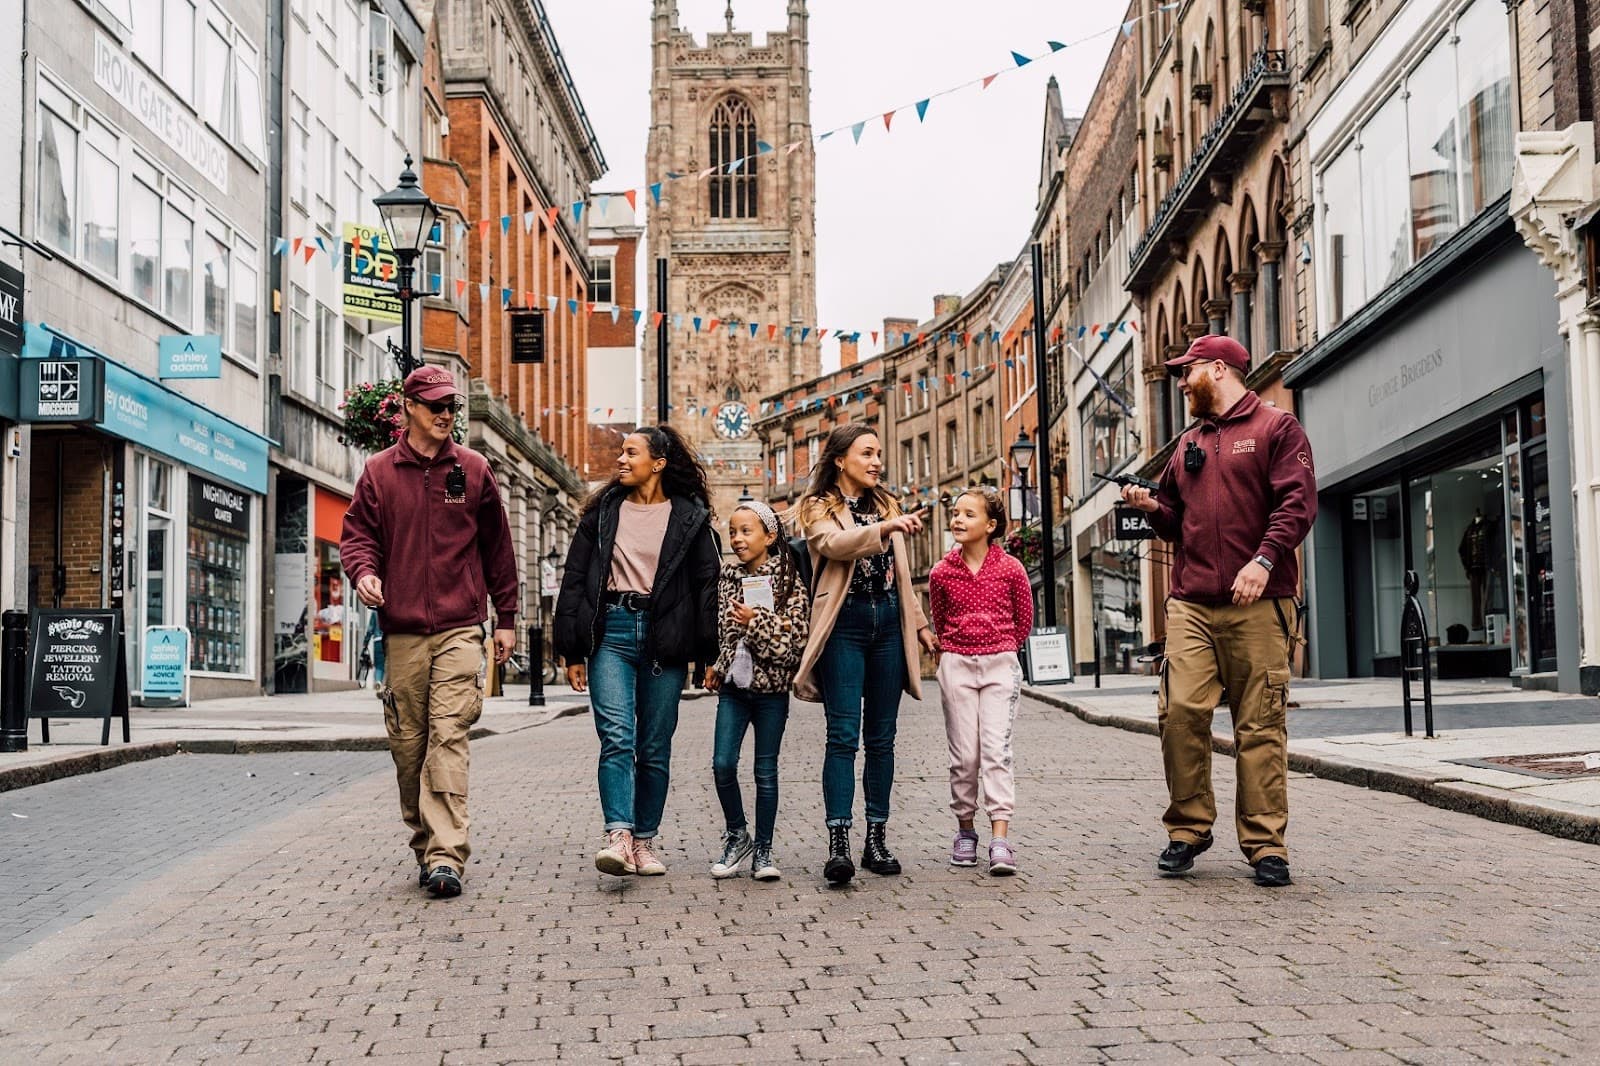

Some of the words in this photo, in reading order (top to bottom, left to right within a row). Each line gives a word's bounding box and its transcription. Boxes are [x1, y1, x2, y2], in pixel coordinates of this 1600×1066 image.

[97, 39, 134, 106] IRON
[138, 80, 173, 138] GATE
[176, 114, 226, 186] STUDIOS
[351, 247, 398, 280] DB
[171, 352, 208, 364] ashley
[170, 362, 209, 373] adams
[105, 384, 117, 411] ley
[119, 395, 148, 421] adams
[203, 483, 243, 512] NIGHTINGALE
[1122, 517, 1152, 530] BEA
[50, 645, 97, 653] PIERCING
[43, 654, 101, 663] JEWELLERY
[50, 665, 91, 673] TATTOO
[45, 673, 95, 681] REMOVAL
